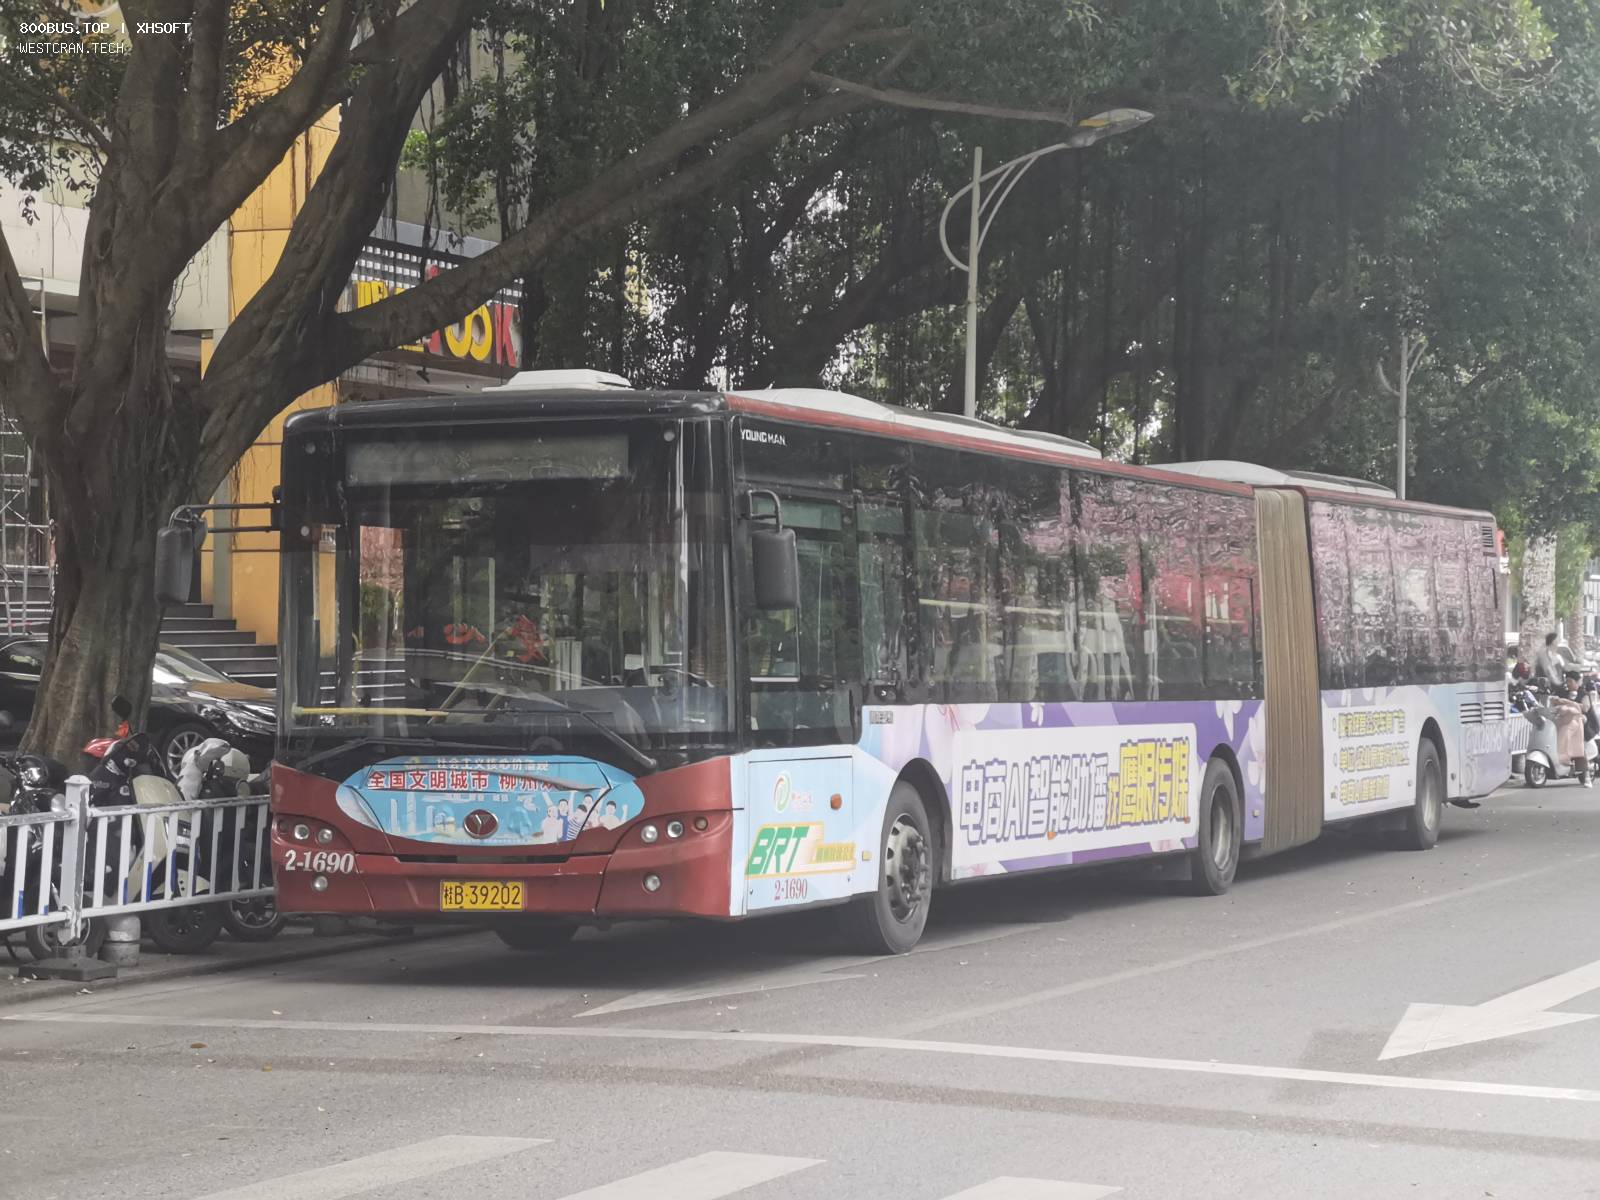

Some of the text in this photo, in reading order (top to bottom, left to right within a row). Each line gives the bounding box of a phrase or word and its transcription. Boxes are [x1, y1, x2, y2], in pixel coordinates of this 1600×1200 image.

[367, 769, 489, 790] 全国文明城市
[284, 849, 355, 874] 2-1690
[744, 826, 811, 876] BRT
